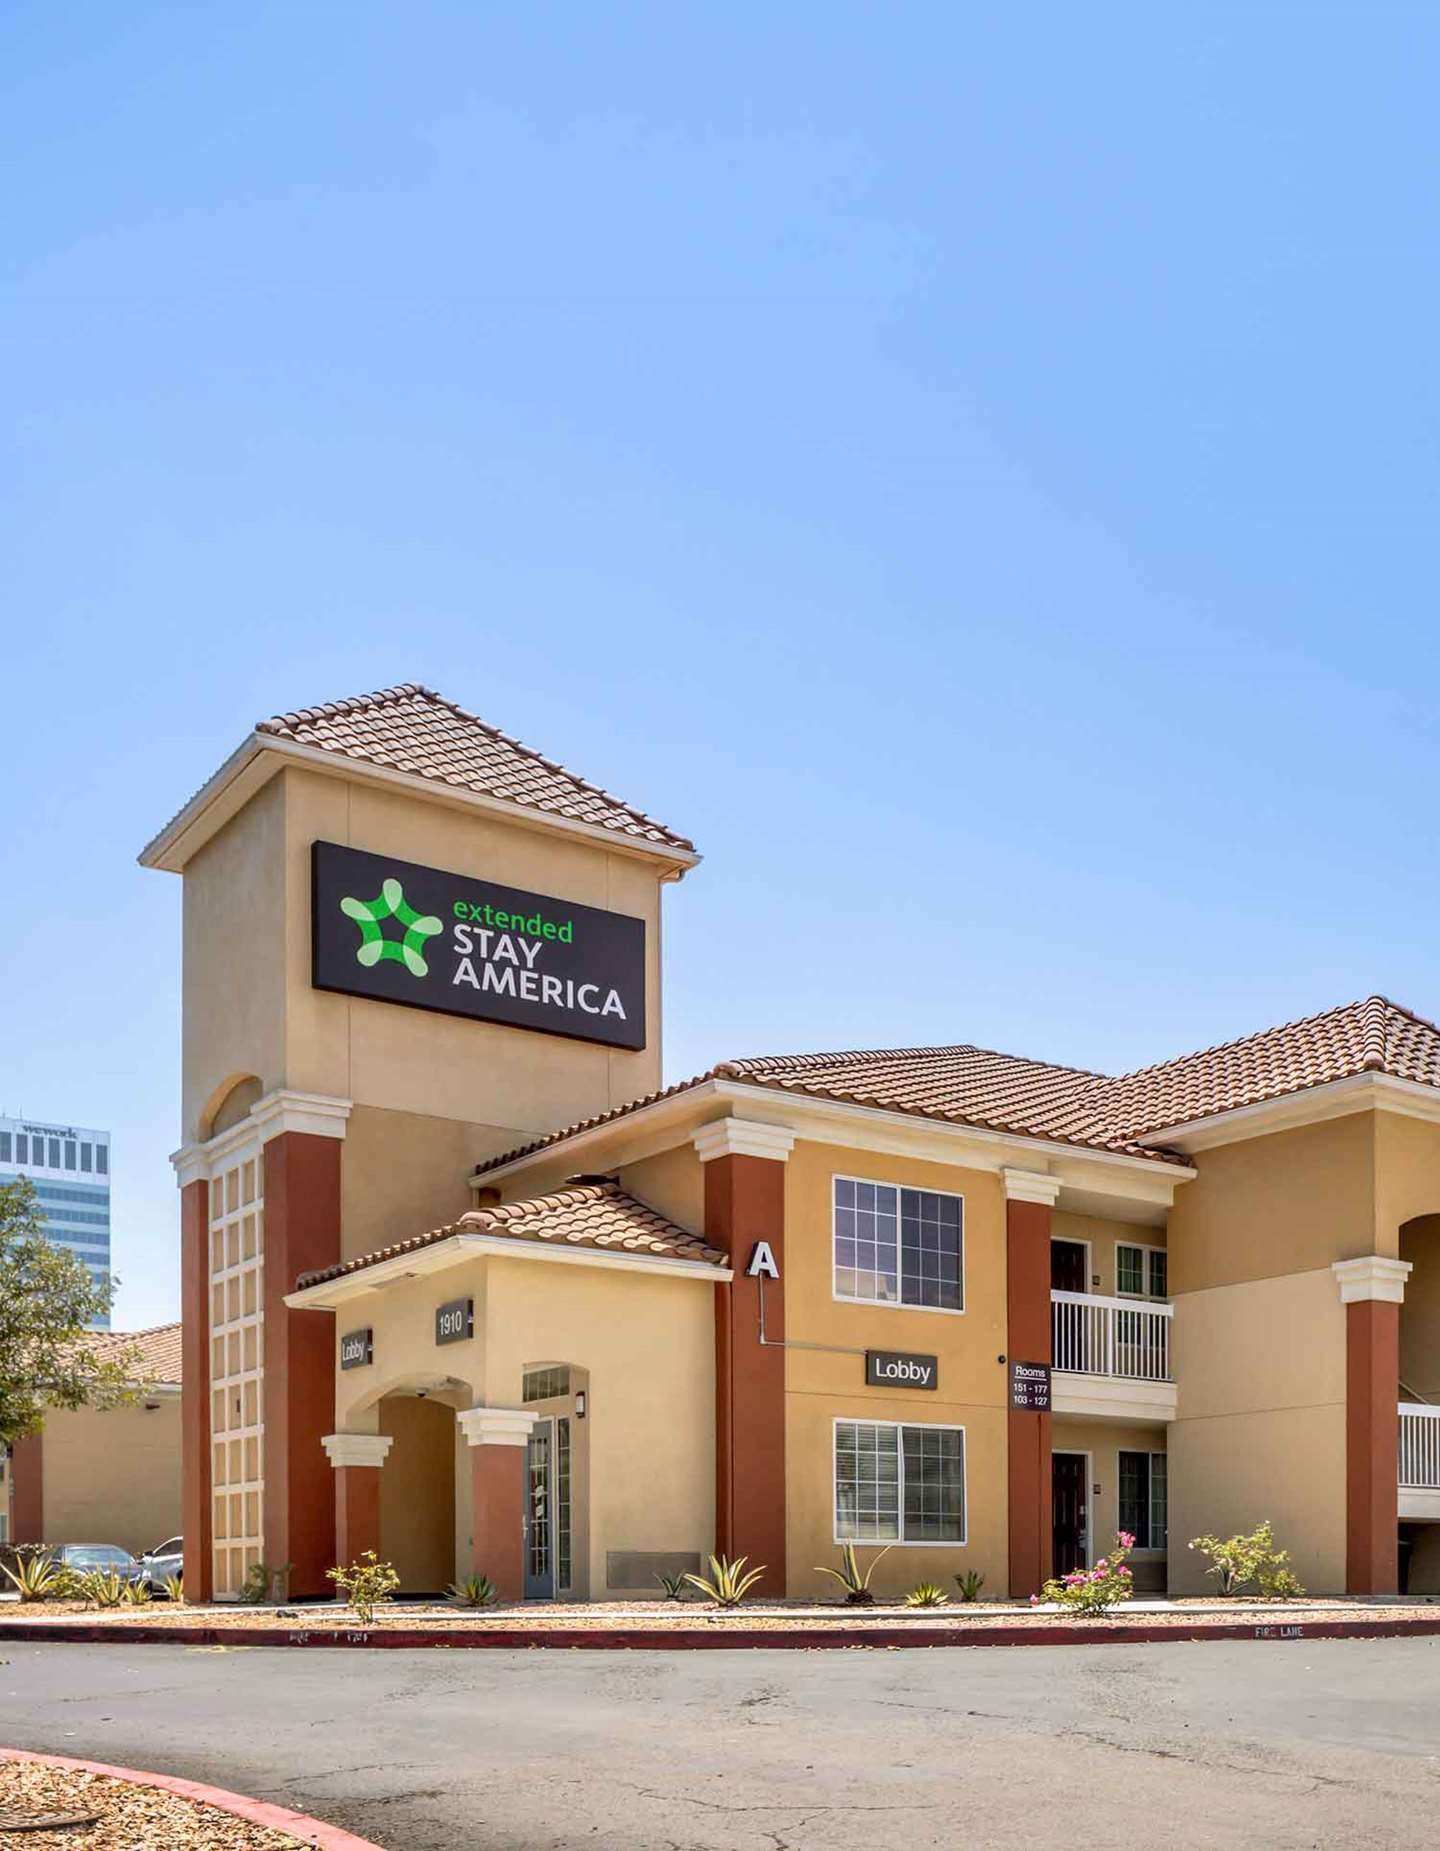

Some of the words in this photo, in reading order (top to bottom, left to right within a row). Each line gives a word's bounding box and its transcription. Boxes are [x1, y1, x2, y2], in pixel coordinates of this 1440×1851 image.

[453, 900, 573, 944] extended
[453, 923, 543, 969] STAY
[452, 957, 627, 1020] AMERICA
[750, 1241, 779, 1279] A
[440, 1310, 462, 1335] 1910
[342, 1339, 365, 1361] Lobby
[875, 1358, 931, 1385] Lobby
[1015, 1366, 1046, 1378] Rooms
[1014, 1383, 1027, 1392] 151
[1034, 1384, 1048, 1393] 177
[1014, 1395, 1028, 1405] 103
[1034, 1396, 1048, 1406] 127
